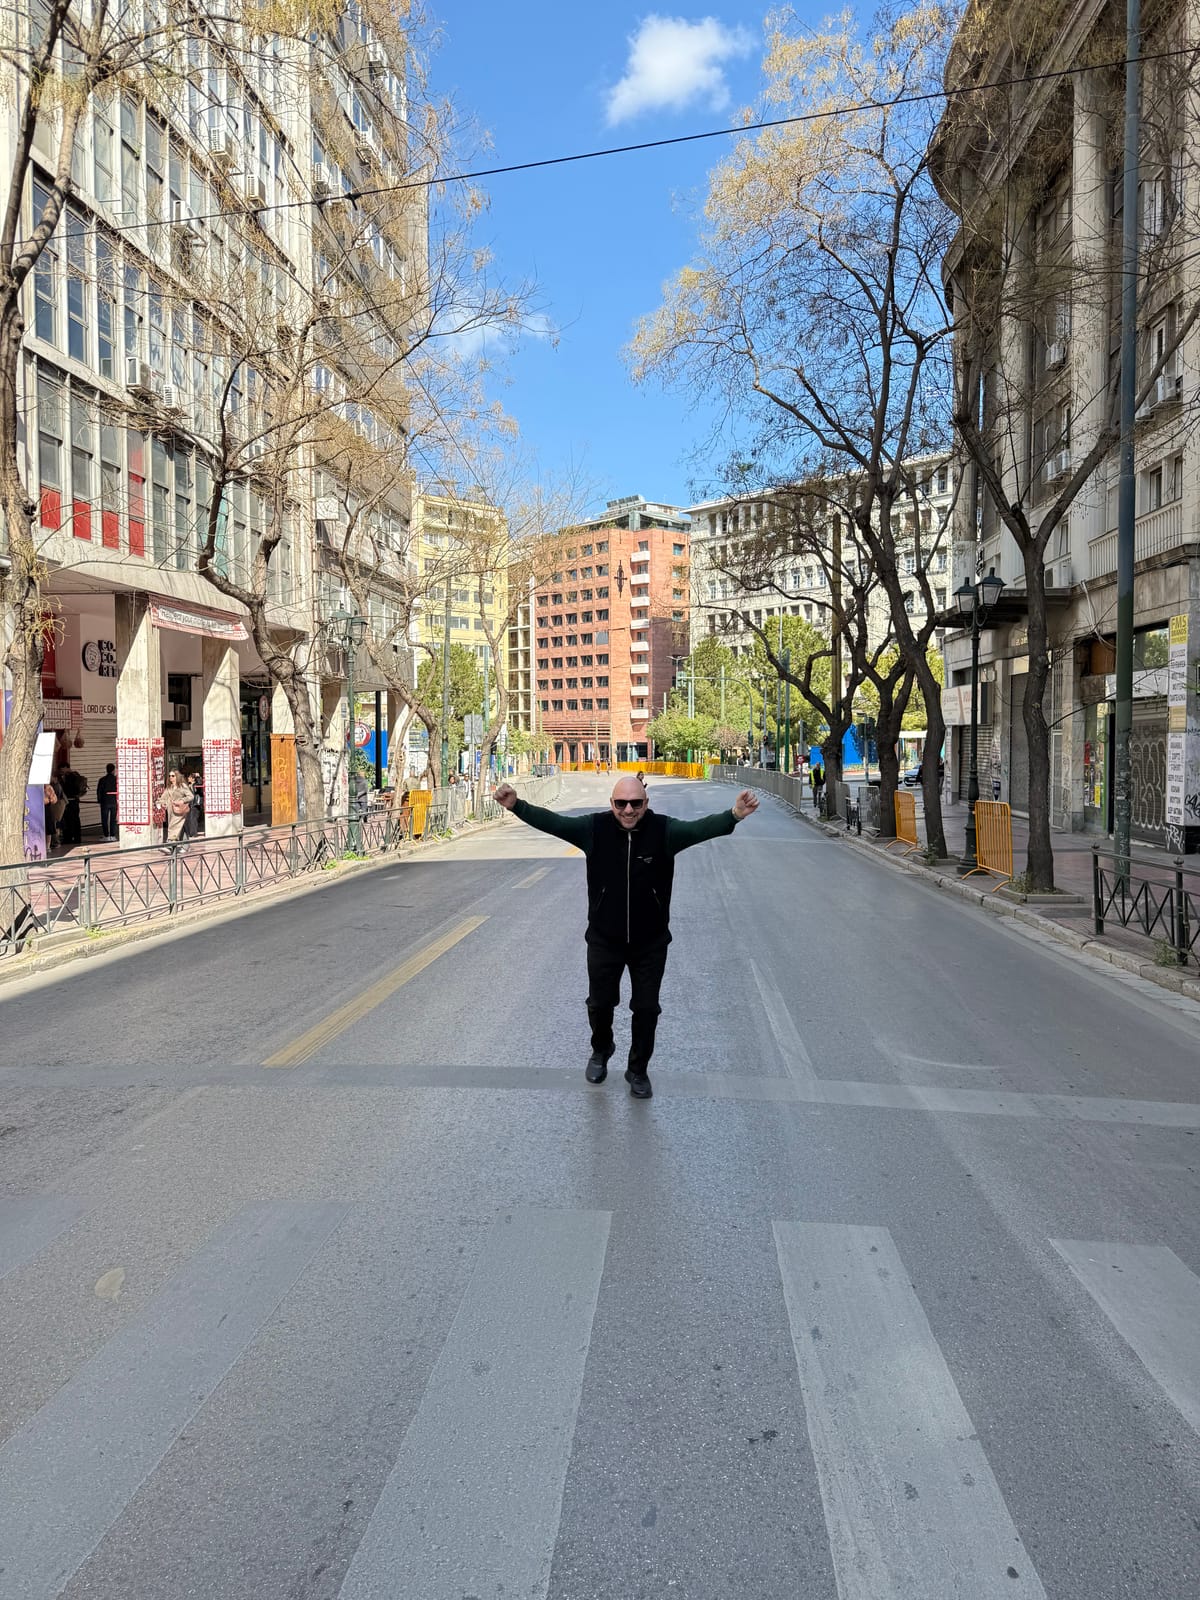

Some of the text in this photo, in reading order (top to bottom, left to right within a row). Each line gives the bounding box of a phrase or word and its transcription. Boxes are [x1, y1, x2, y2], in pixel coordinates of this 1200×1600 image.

[1171, 615, 1187, 630] FMS
[83, 704, 98, 714] LORD
[99, 704, 107, 714] OF
